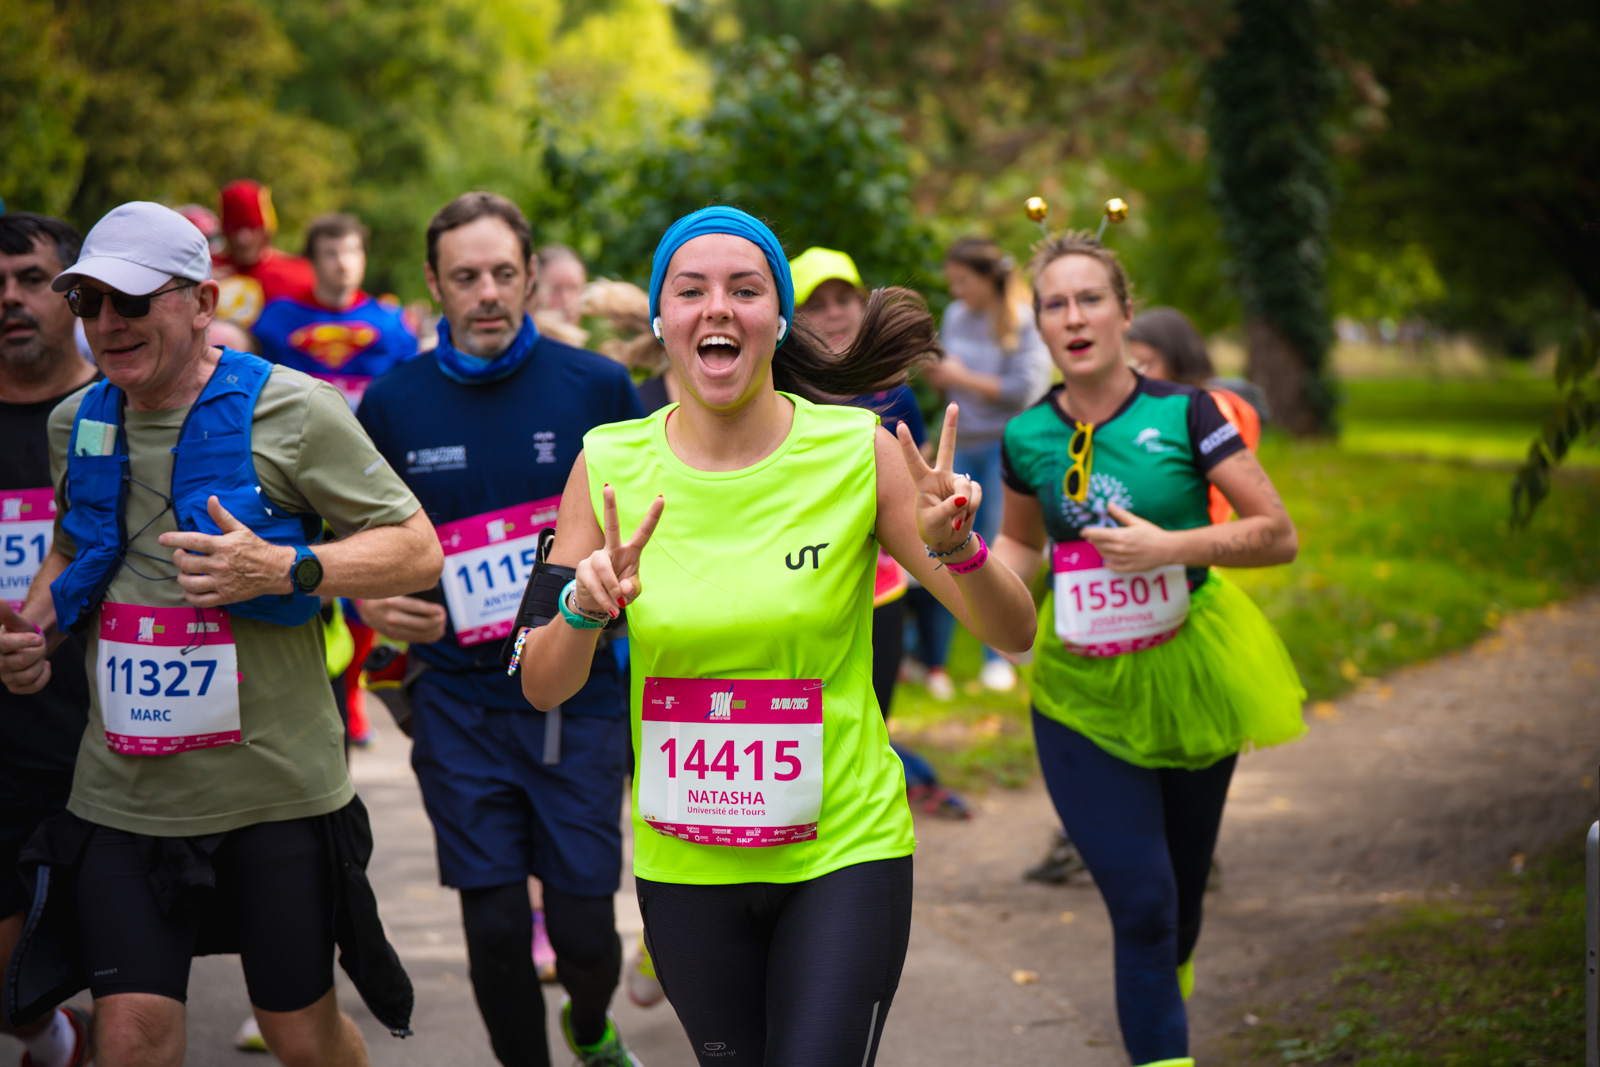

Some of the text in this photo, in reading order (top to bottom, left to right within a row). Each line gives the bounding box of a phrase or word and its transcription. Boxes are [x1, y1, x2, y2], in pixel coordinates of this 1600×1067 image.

[1070, 573, 1169, 612] 15501
[107, 656, 217, 697] 11327
[710, 692, 733, 717] 10K
[770, 697, 809, 710] 28/09/2025
[130, 708, 172, 722] MARC
[660, 738, 802, 781] 14415
[688, 789, 765, 805] NATASHA
[687, 806, 766, 816] Université de Tours
